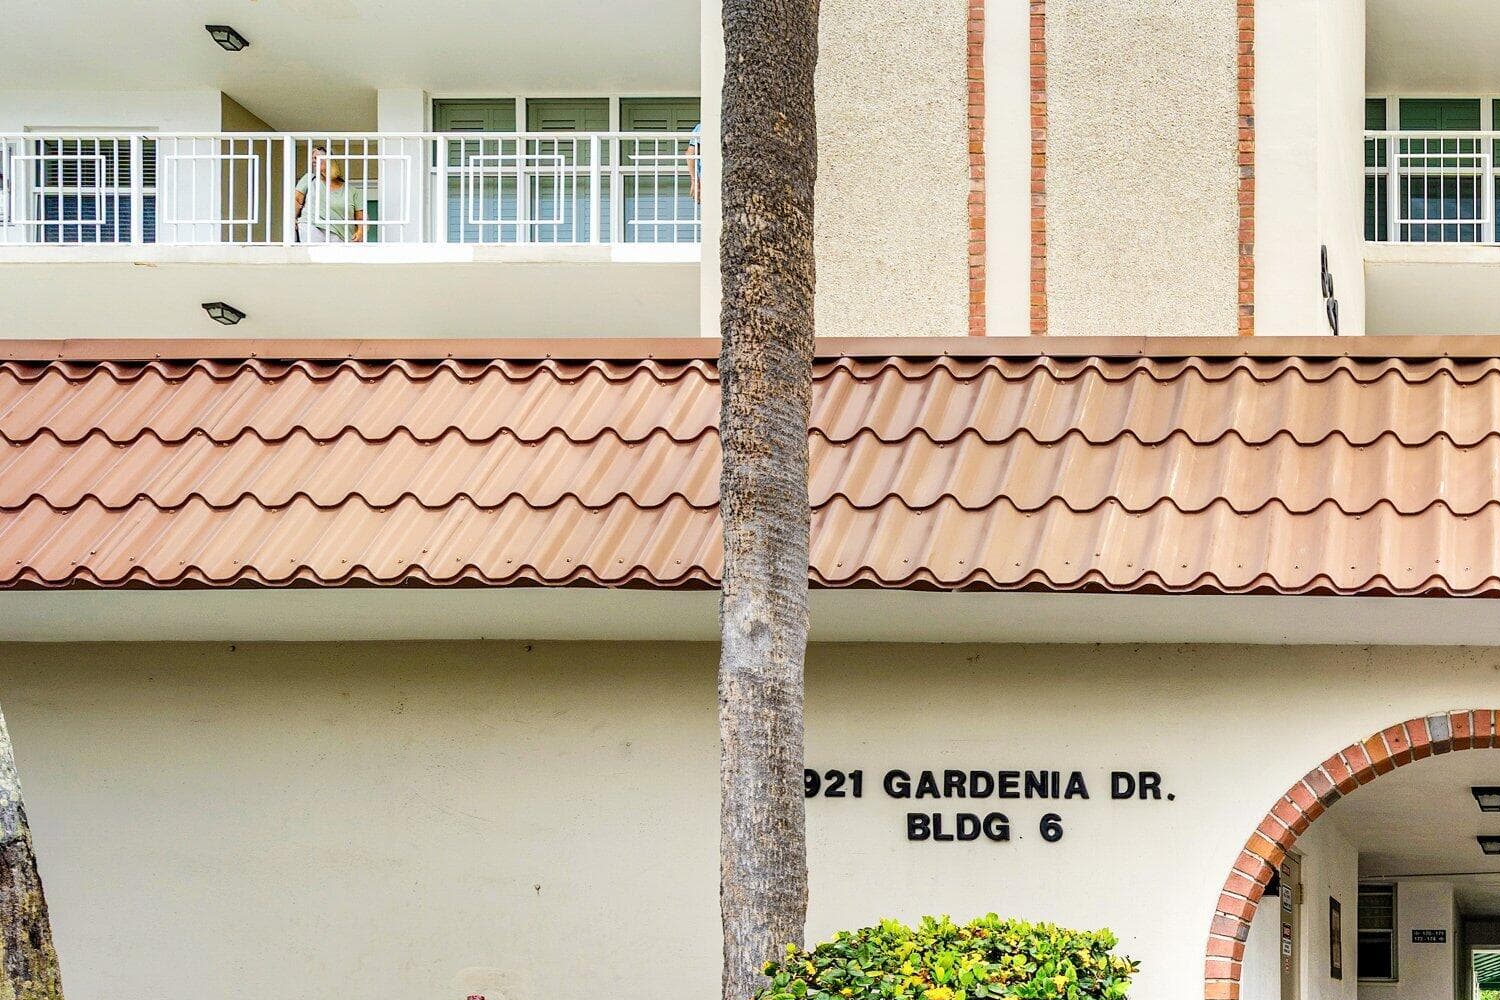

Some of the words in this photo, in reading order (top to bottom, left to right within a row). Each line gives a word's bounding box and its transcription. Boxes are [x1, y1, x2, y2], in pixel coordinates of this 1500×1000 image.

[804, 769, 863, 798] 921
[883, 769, 1090, 800] GARDENIA
[1111, 771, 1176, 802] DR.
[907, 812, 1011, 842] BLDG
[1039, 813, 1064, 843] 6
